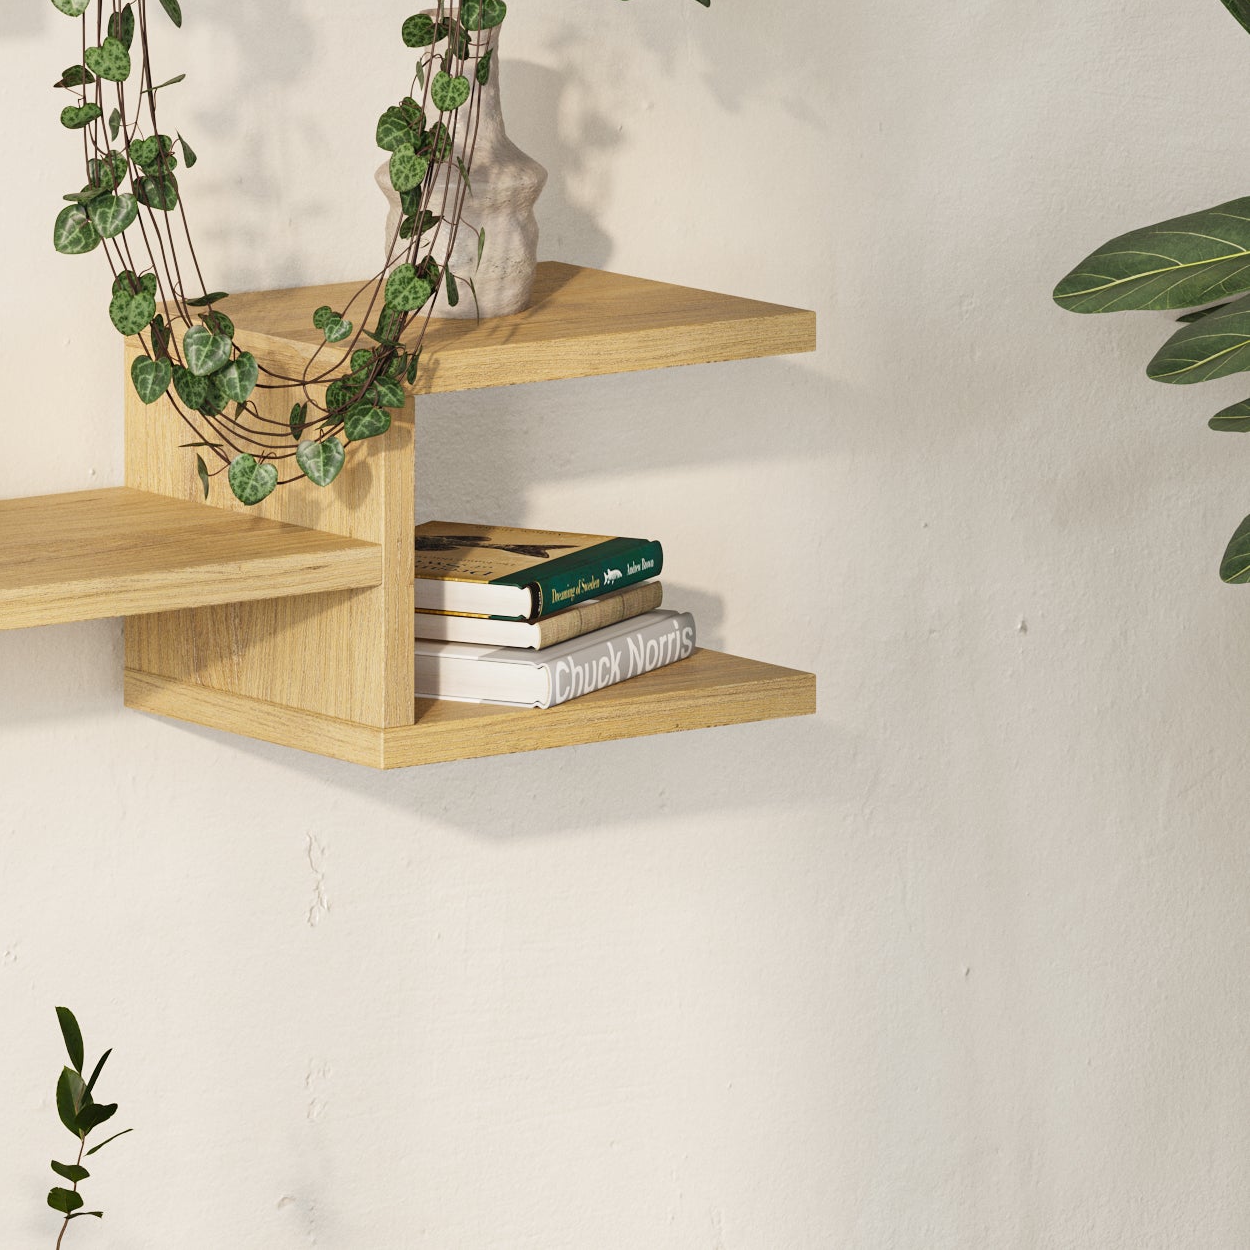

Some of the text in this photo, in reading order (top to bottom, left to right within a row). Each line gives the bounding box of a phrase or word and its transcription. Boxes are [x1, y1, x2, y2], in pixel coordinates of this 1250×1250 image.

[552, 575, 600, 604] Dreaming of Sweden
[555, 619, 694, 704] Chuck Norris
